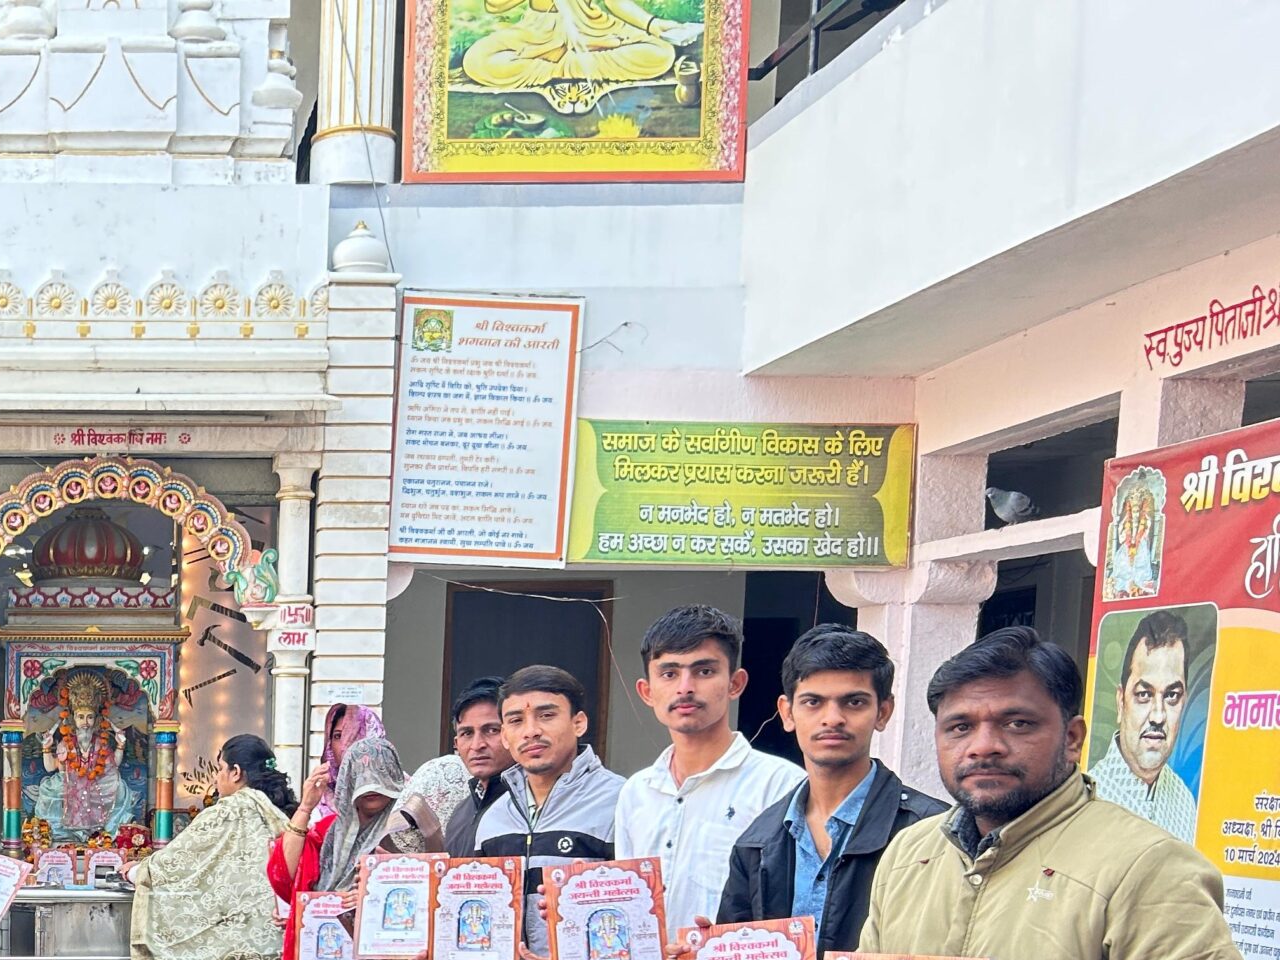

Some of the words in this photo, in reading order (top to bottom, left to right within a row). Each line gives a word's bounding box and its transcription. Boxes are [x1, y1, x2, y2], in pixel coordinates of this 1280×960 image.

[492, 320, 548, 334] विश्वकर्मा
[1209, 284, 1266, 350] पिताजी
[457, 337, 501, 348] भगवान
[503, 336, 520, 349] की
[523, 337, 561, 351] आरती
[70, 428, 86, 446] श्री
[601, 432, 656, 452] समाज
[661, 427, 681, 452] के
[761, 429, 820, 456] विकास
[824, 430, 844, 456] के
[848, 430, 884, 457] लिए
[613, 455, 680, 482] मिलकर
[683, 462, 733, 487] प्रयास
[735, 464, 785, 485] करना
[789, 459, 842, 485] जरूरी
[1180, 455, 1219, 512] श्री
[640, 504, 654, 522] न
[657, 499, 710, 526] मनभेद
[741, 506, 756, 526] न
[759, 501, 811, 528] मतभेद
[598, 531, 623, 552] हम
[628, 532, 668, 554] अच्छा
[672, 533, 686, 552] न
[689, 534, 718, 555] कर
[761, 535, 809, 556] उसका
[812, 534, 843, 557] खेद
[278, 631, 309, 647] लाभ
[1260, 818, 1273, 838] श्री
[1224, 848, 1236, 863] 10
[1238, 844, 1257, 865] मार्च
